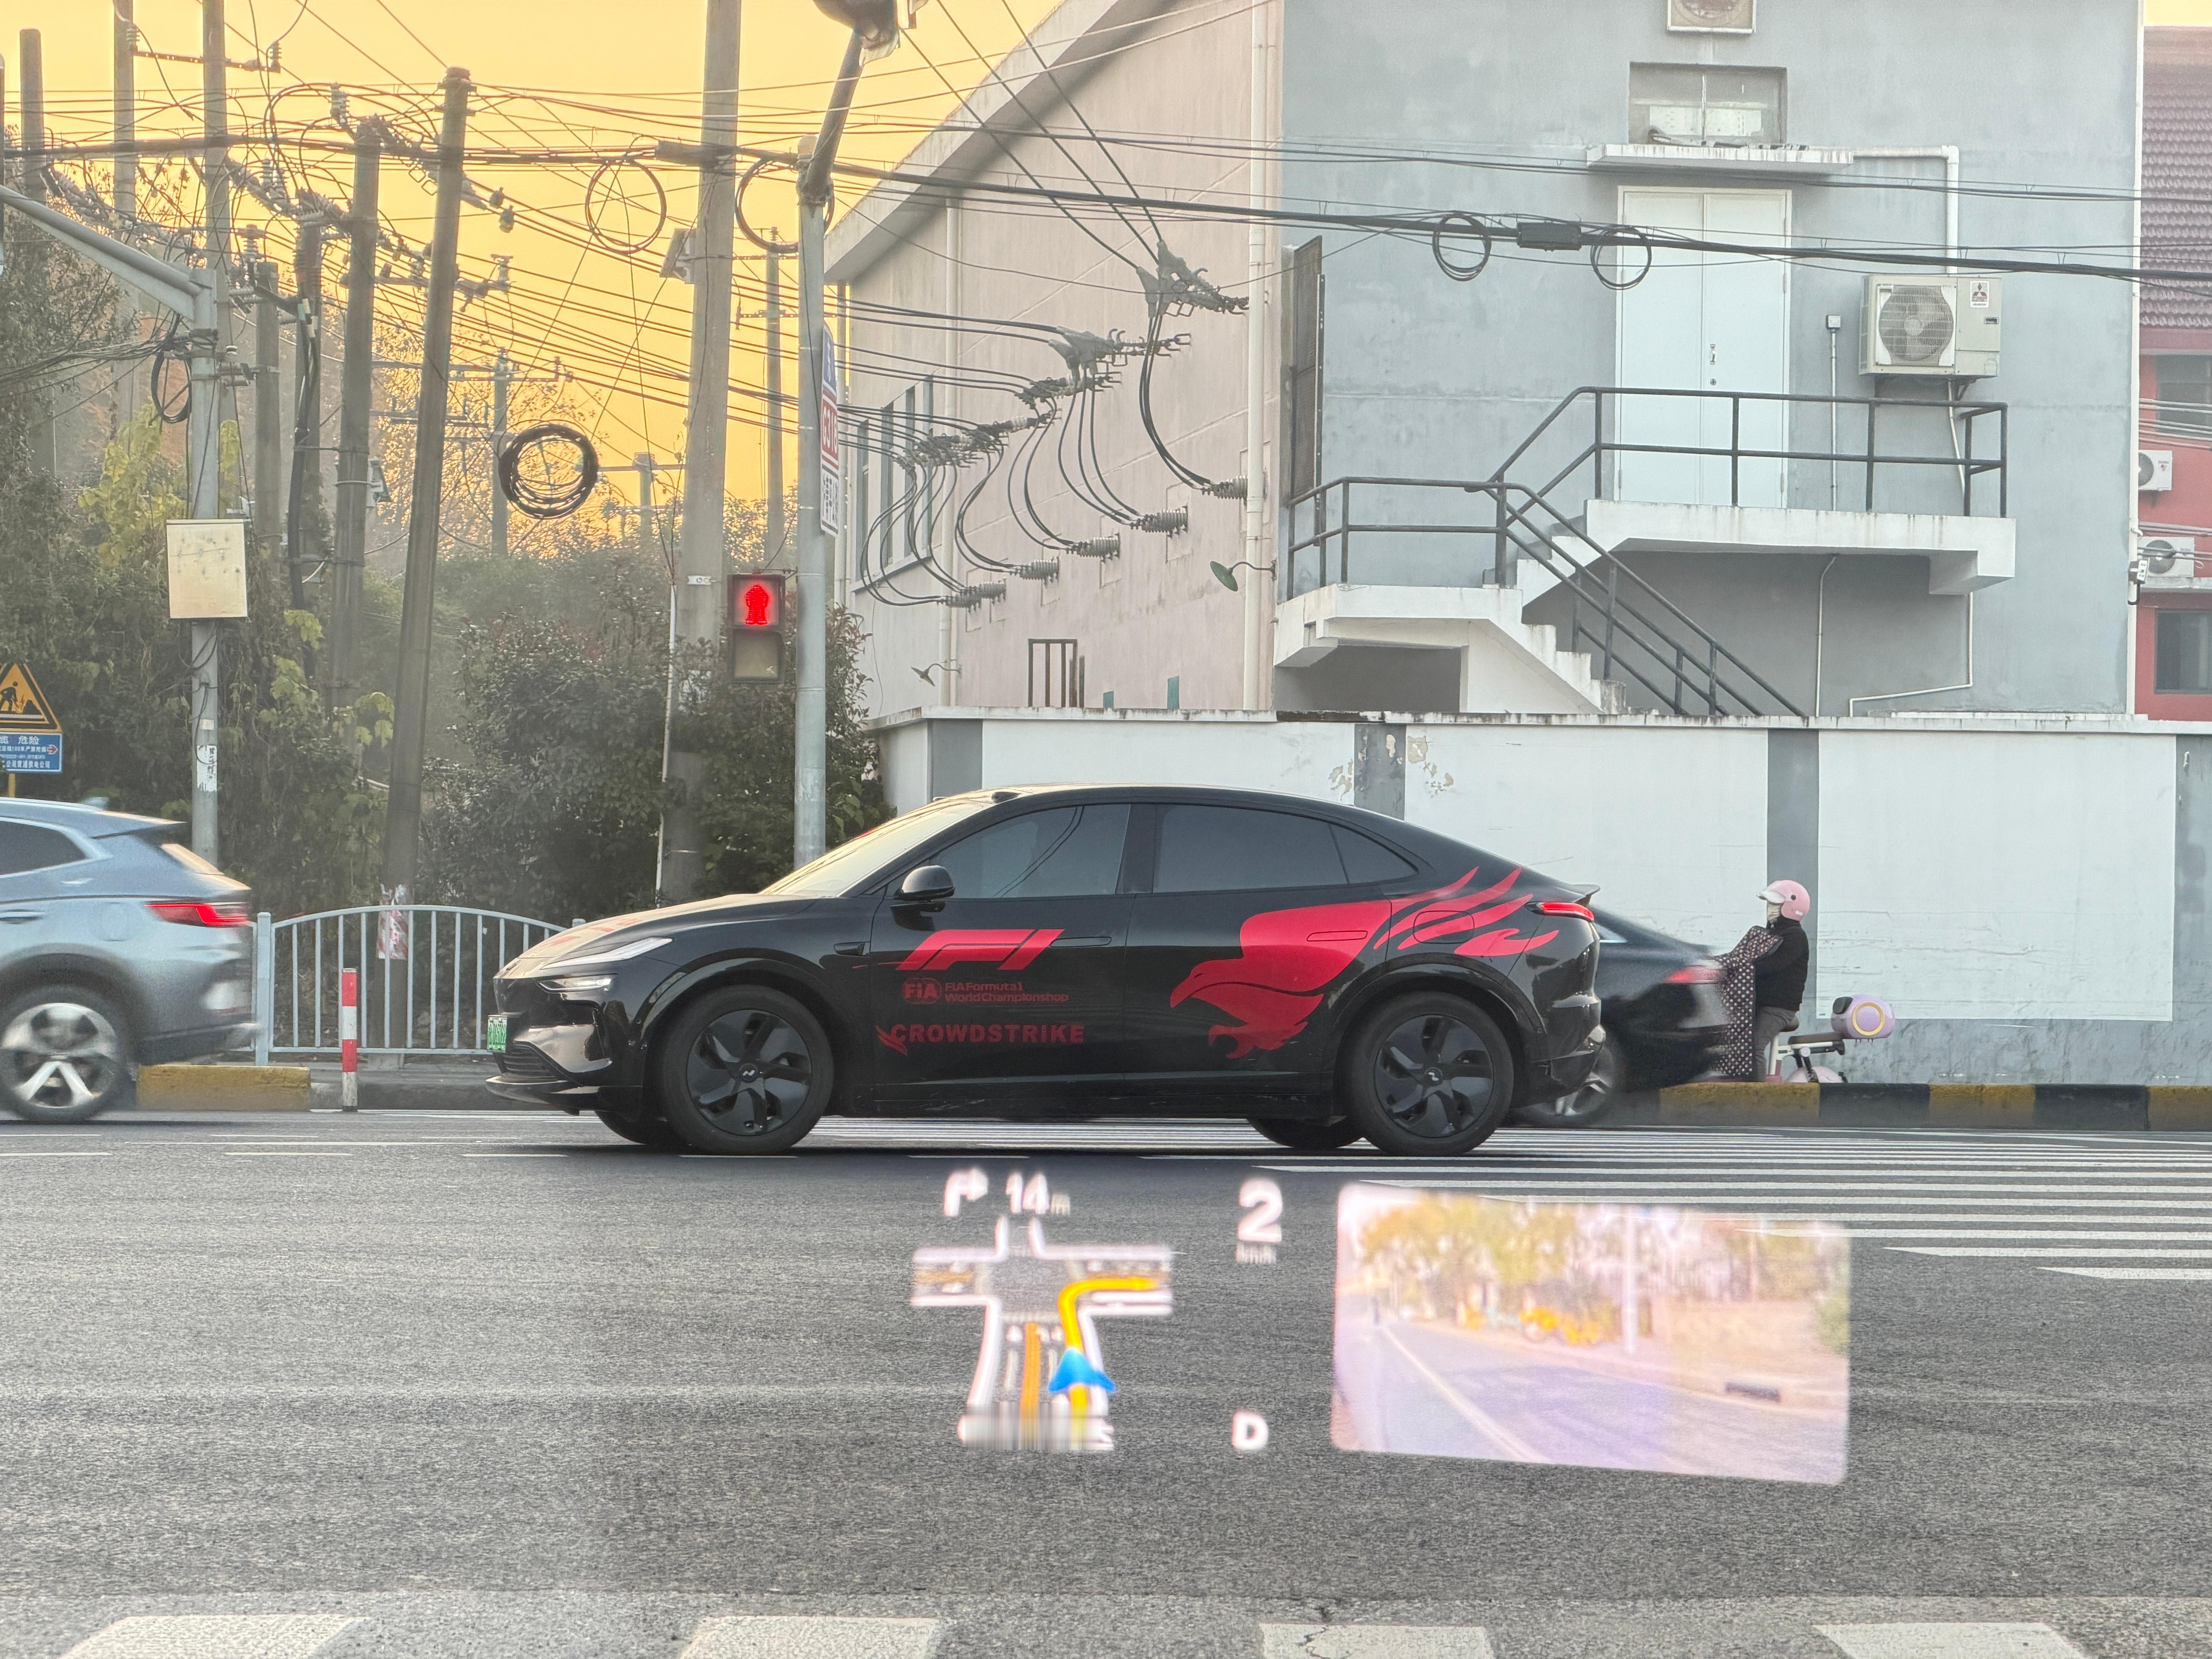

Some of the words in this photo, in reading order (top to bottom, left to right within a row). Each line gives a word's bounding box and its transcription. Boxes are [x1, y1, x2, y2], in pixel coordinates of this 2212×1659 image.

[823, 406, 837, 454] G318
[18, 735, 39, 745] 危险
[896, 929, 1065, 970] F1
[904, 983, 938, 999] FIA
[945, 982, 964, 991] FIA
[945, 993, 981, 1001] World
[891, 1024, 1085, 1044] CROWDSTRIKE
[1238, 1176, 1283, 1243] 2
[1231, 1412, 1268, 1449] D
